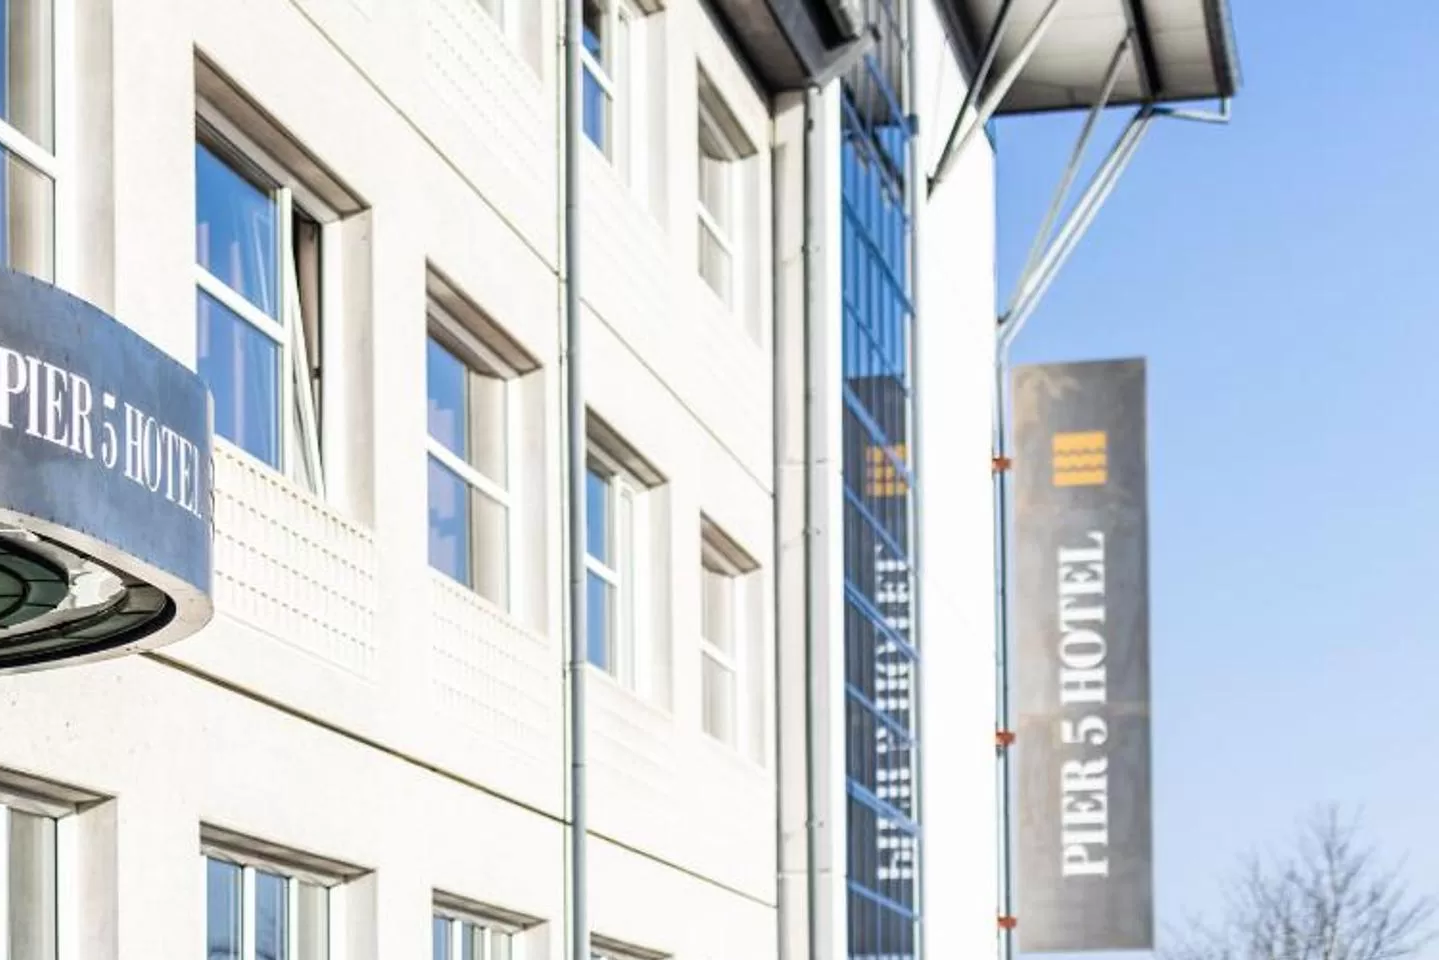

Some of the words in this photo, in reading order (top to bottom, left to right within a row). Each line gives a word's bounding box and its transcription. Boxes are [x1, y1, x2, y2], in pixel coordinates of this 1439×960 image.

[101, 391, 118, 469] 5
[123, 401, 203, 519] HOTEL
[1057, 530, 1106, 704] HOTEL
[1061, 714, 1108, 746] 5
[1062, 755, 1109, 878] PIER
